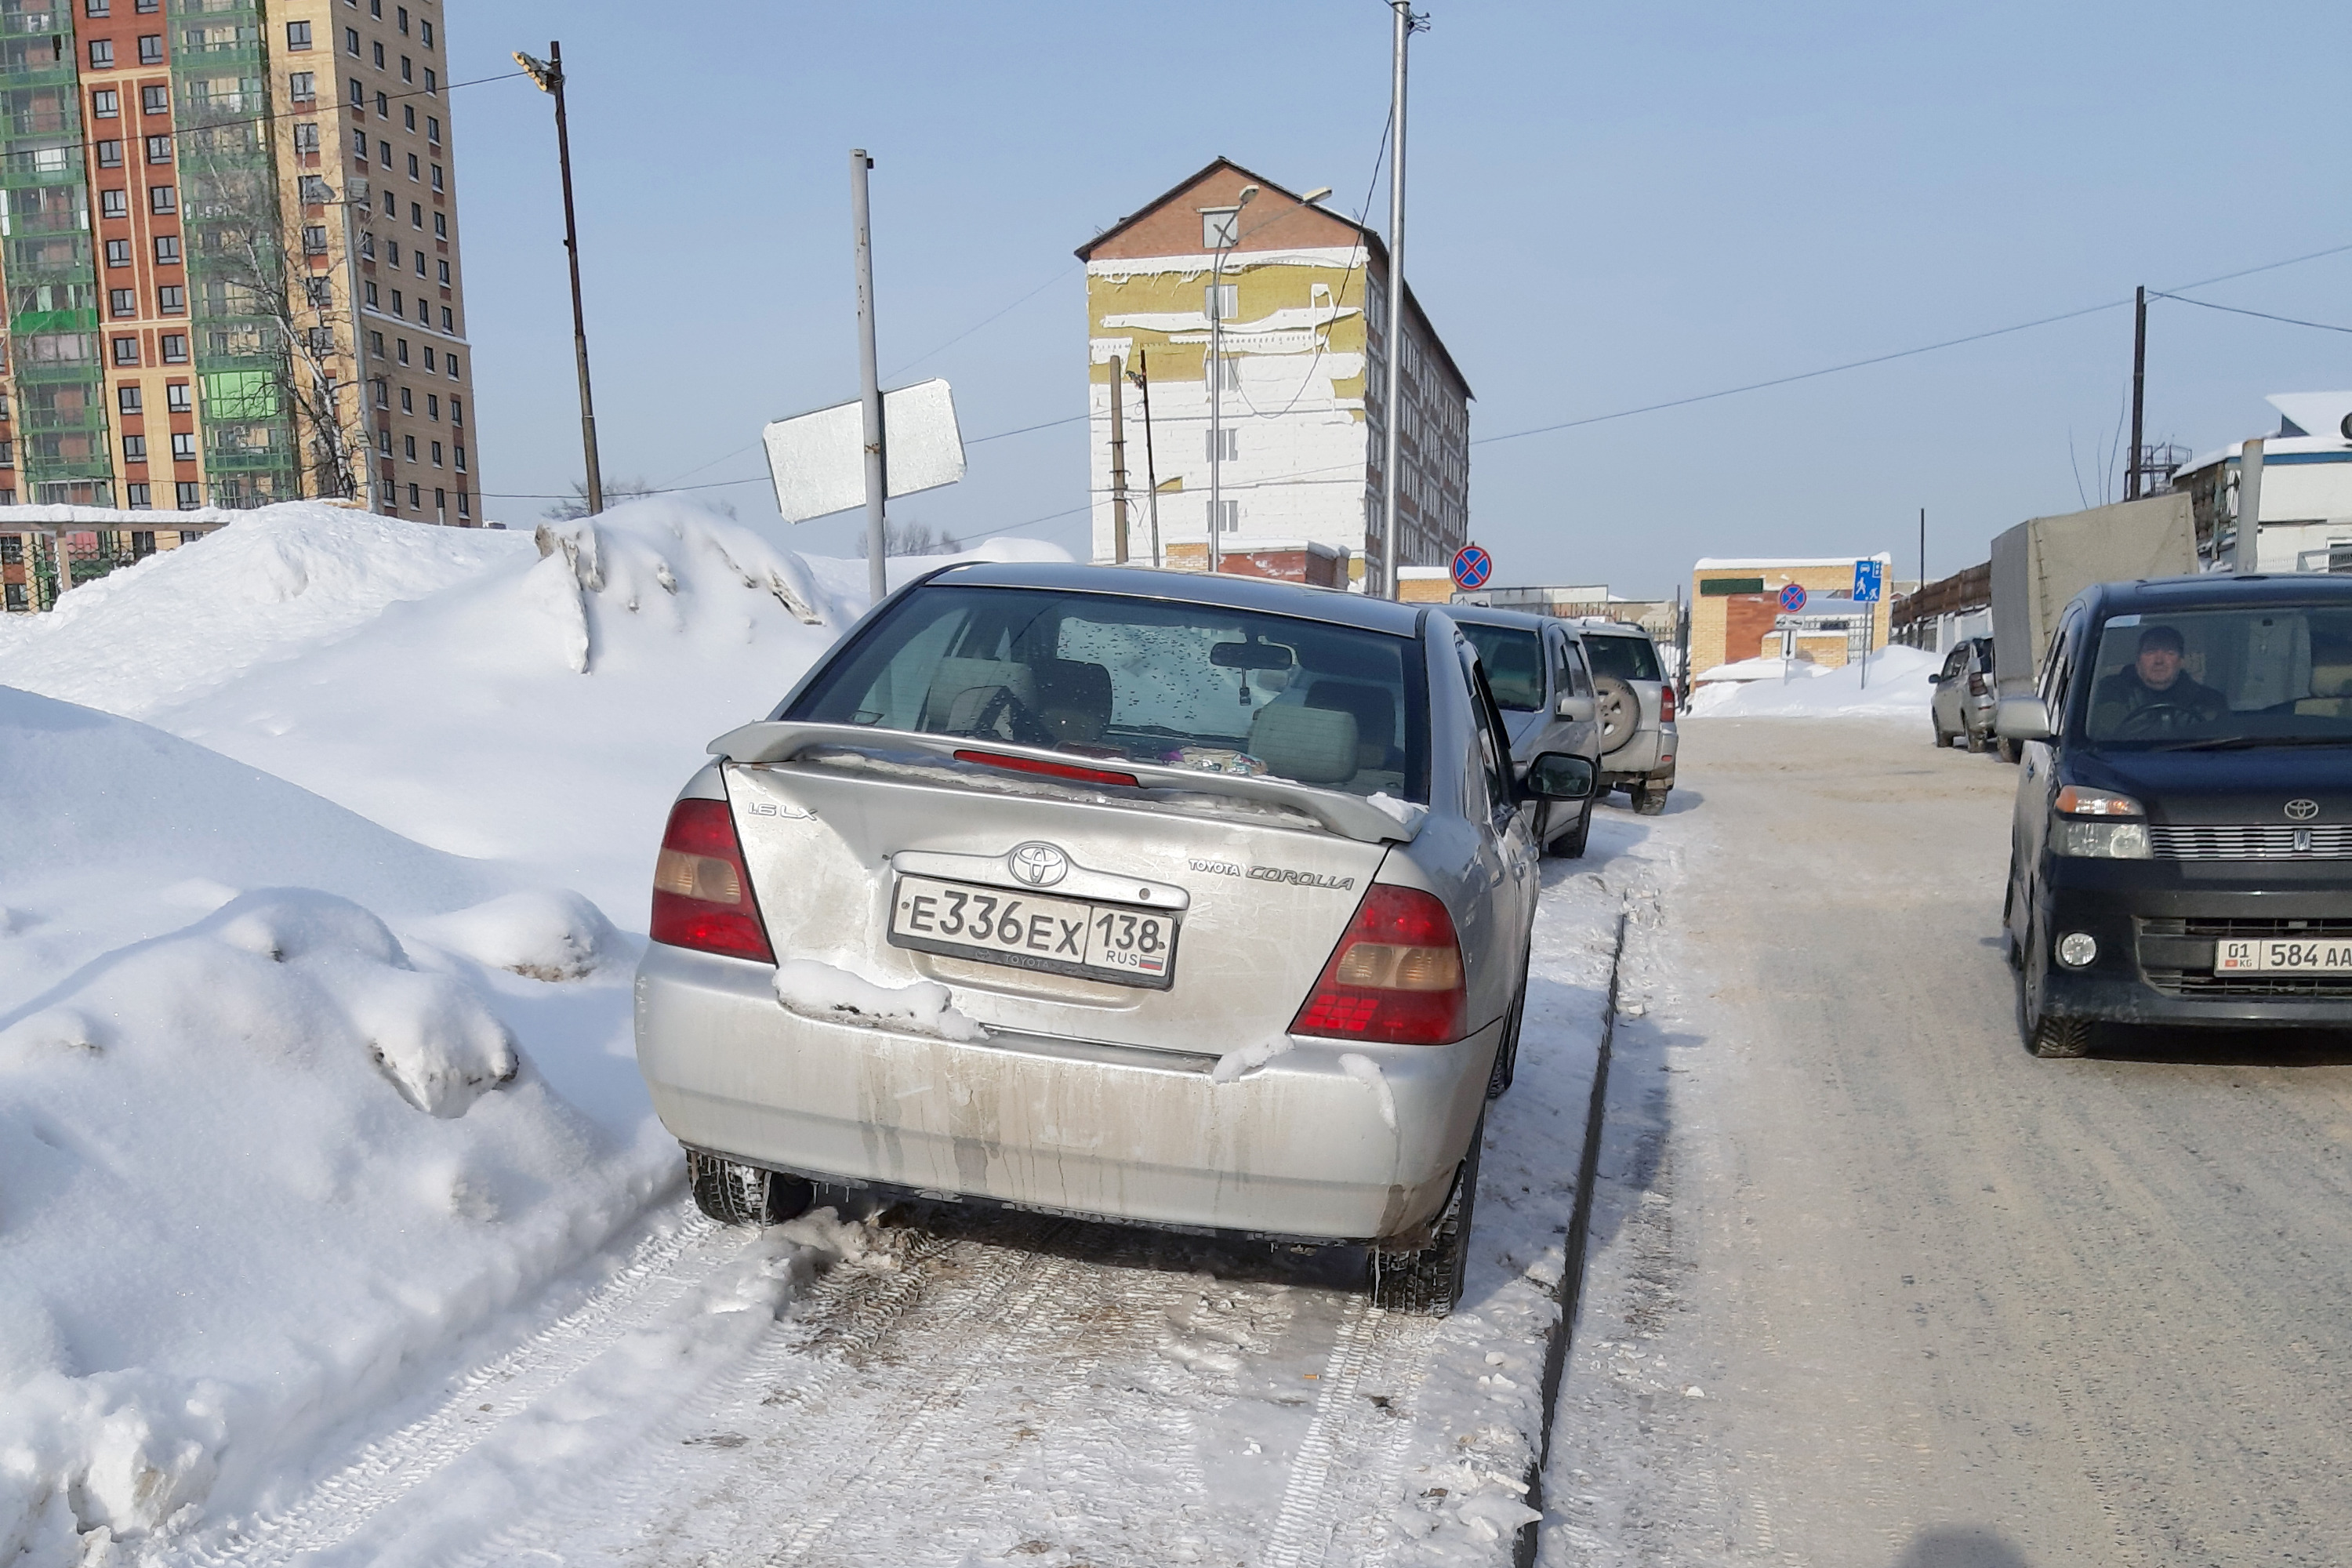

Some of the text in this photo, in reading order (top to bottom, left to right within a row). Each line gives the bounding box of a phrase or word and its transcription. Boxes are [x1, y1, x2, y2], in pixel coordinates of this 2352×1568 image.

[1189, 859, 1355, 891] TOYOTA COROLLA
[1096, 913, 1160, 953] 138
[1004, 954, 1050, 968] TOYOTA
[1105, 949, 1138, 966] RUS
[2228, 943, 2249, 958] 01
[2270, 943, 2318, 967] 584
